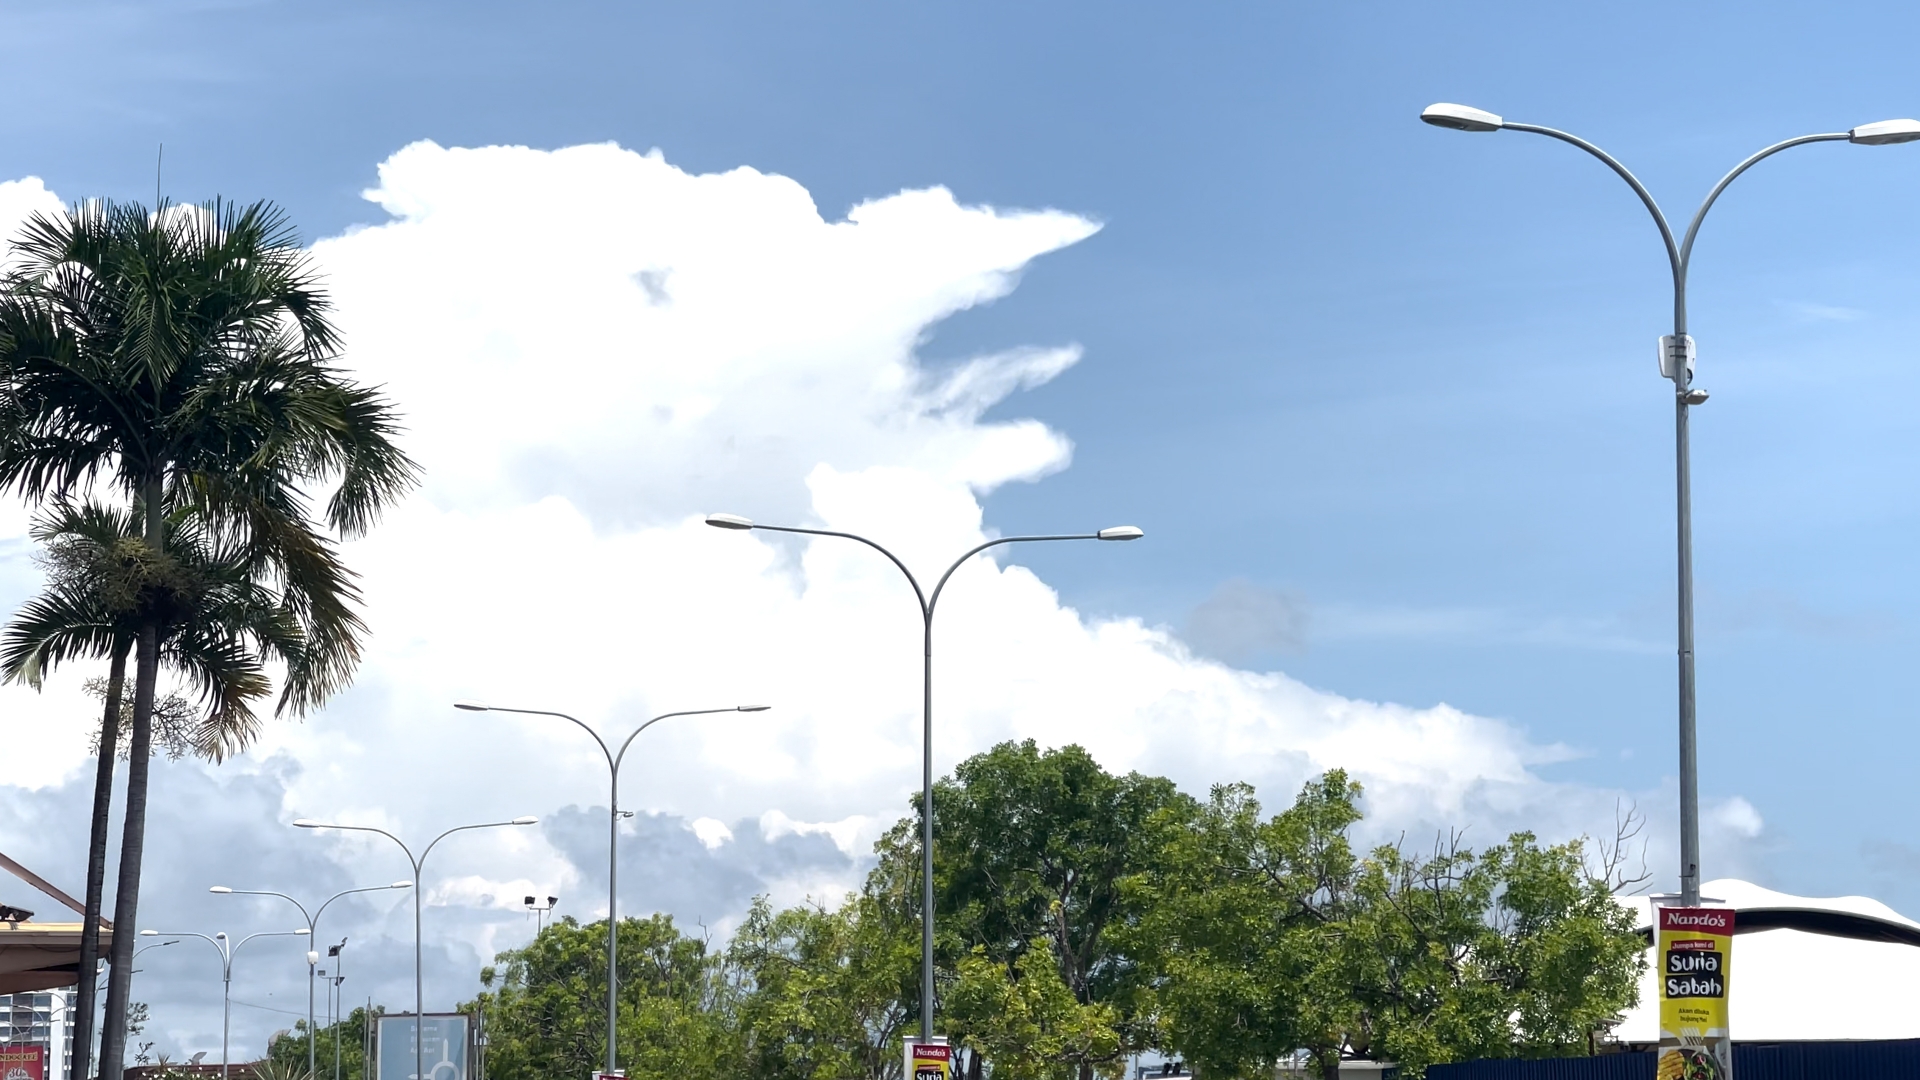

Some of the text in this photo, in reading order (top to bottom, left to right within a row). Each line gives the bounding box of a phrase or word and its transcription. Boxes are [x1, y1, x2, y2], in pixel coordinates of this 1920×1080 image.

[1667, 913, 1726, 927] Nando's
[1671, 952, 1717, 972] Suria
[1668, 977, 1722, 996] Sabah
[916, 1048, 946, 1056] Nando's
